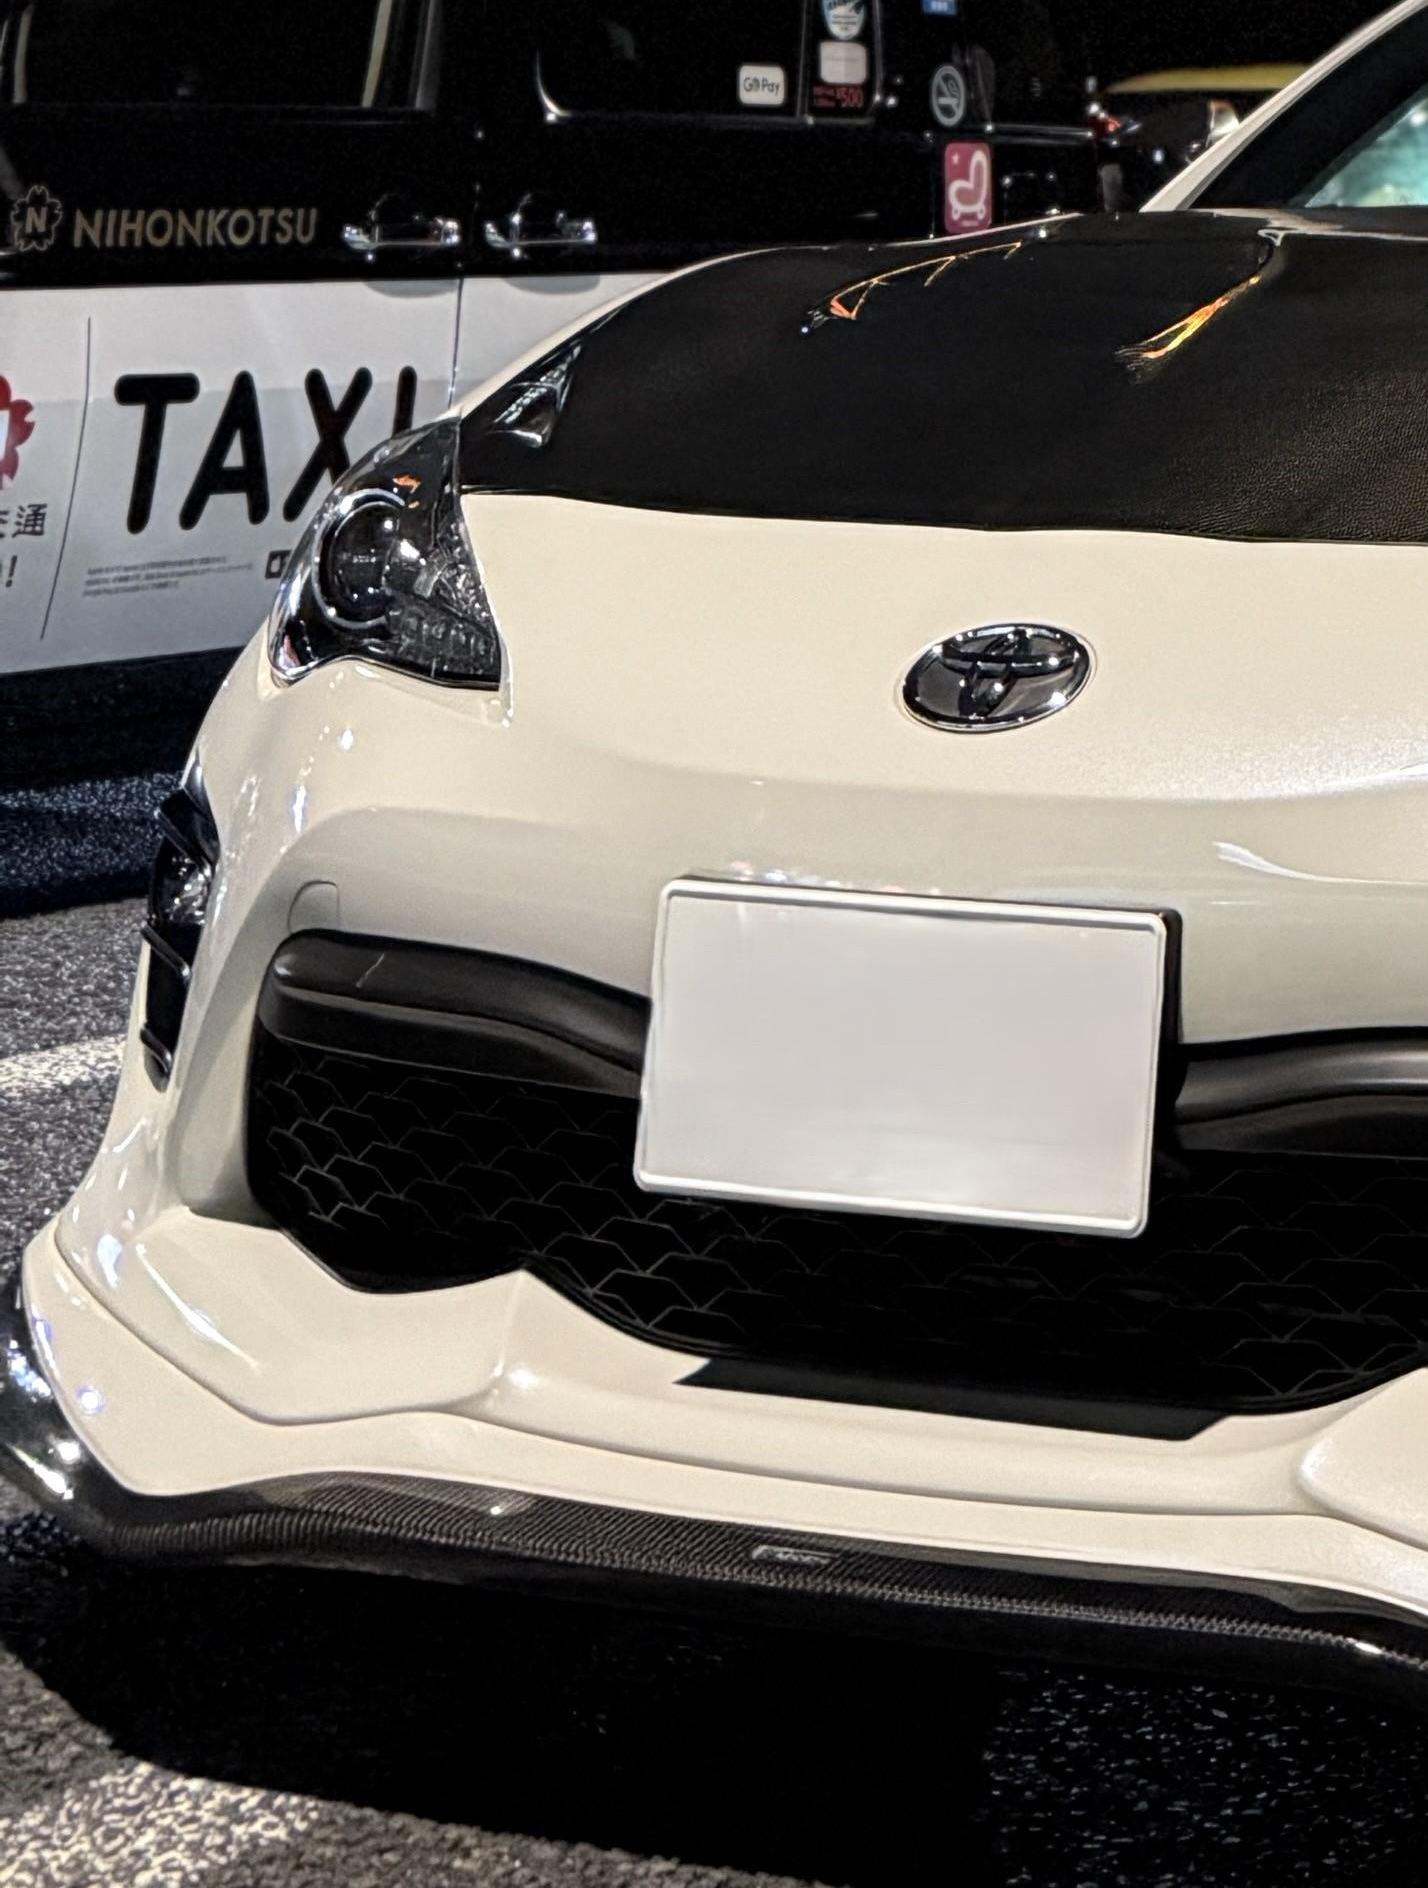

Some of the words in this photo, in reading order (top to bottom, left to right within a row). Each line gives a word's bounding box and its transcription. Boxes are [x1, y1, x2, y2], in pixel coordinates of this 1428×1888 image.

[761, 77, 780, 96] Pay
[25, 207, 48, 233] N
[73, 208, 318, 248] NIHONKOTSU
